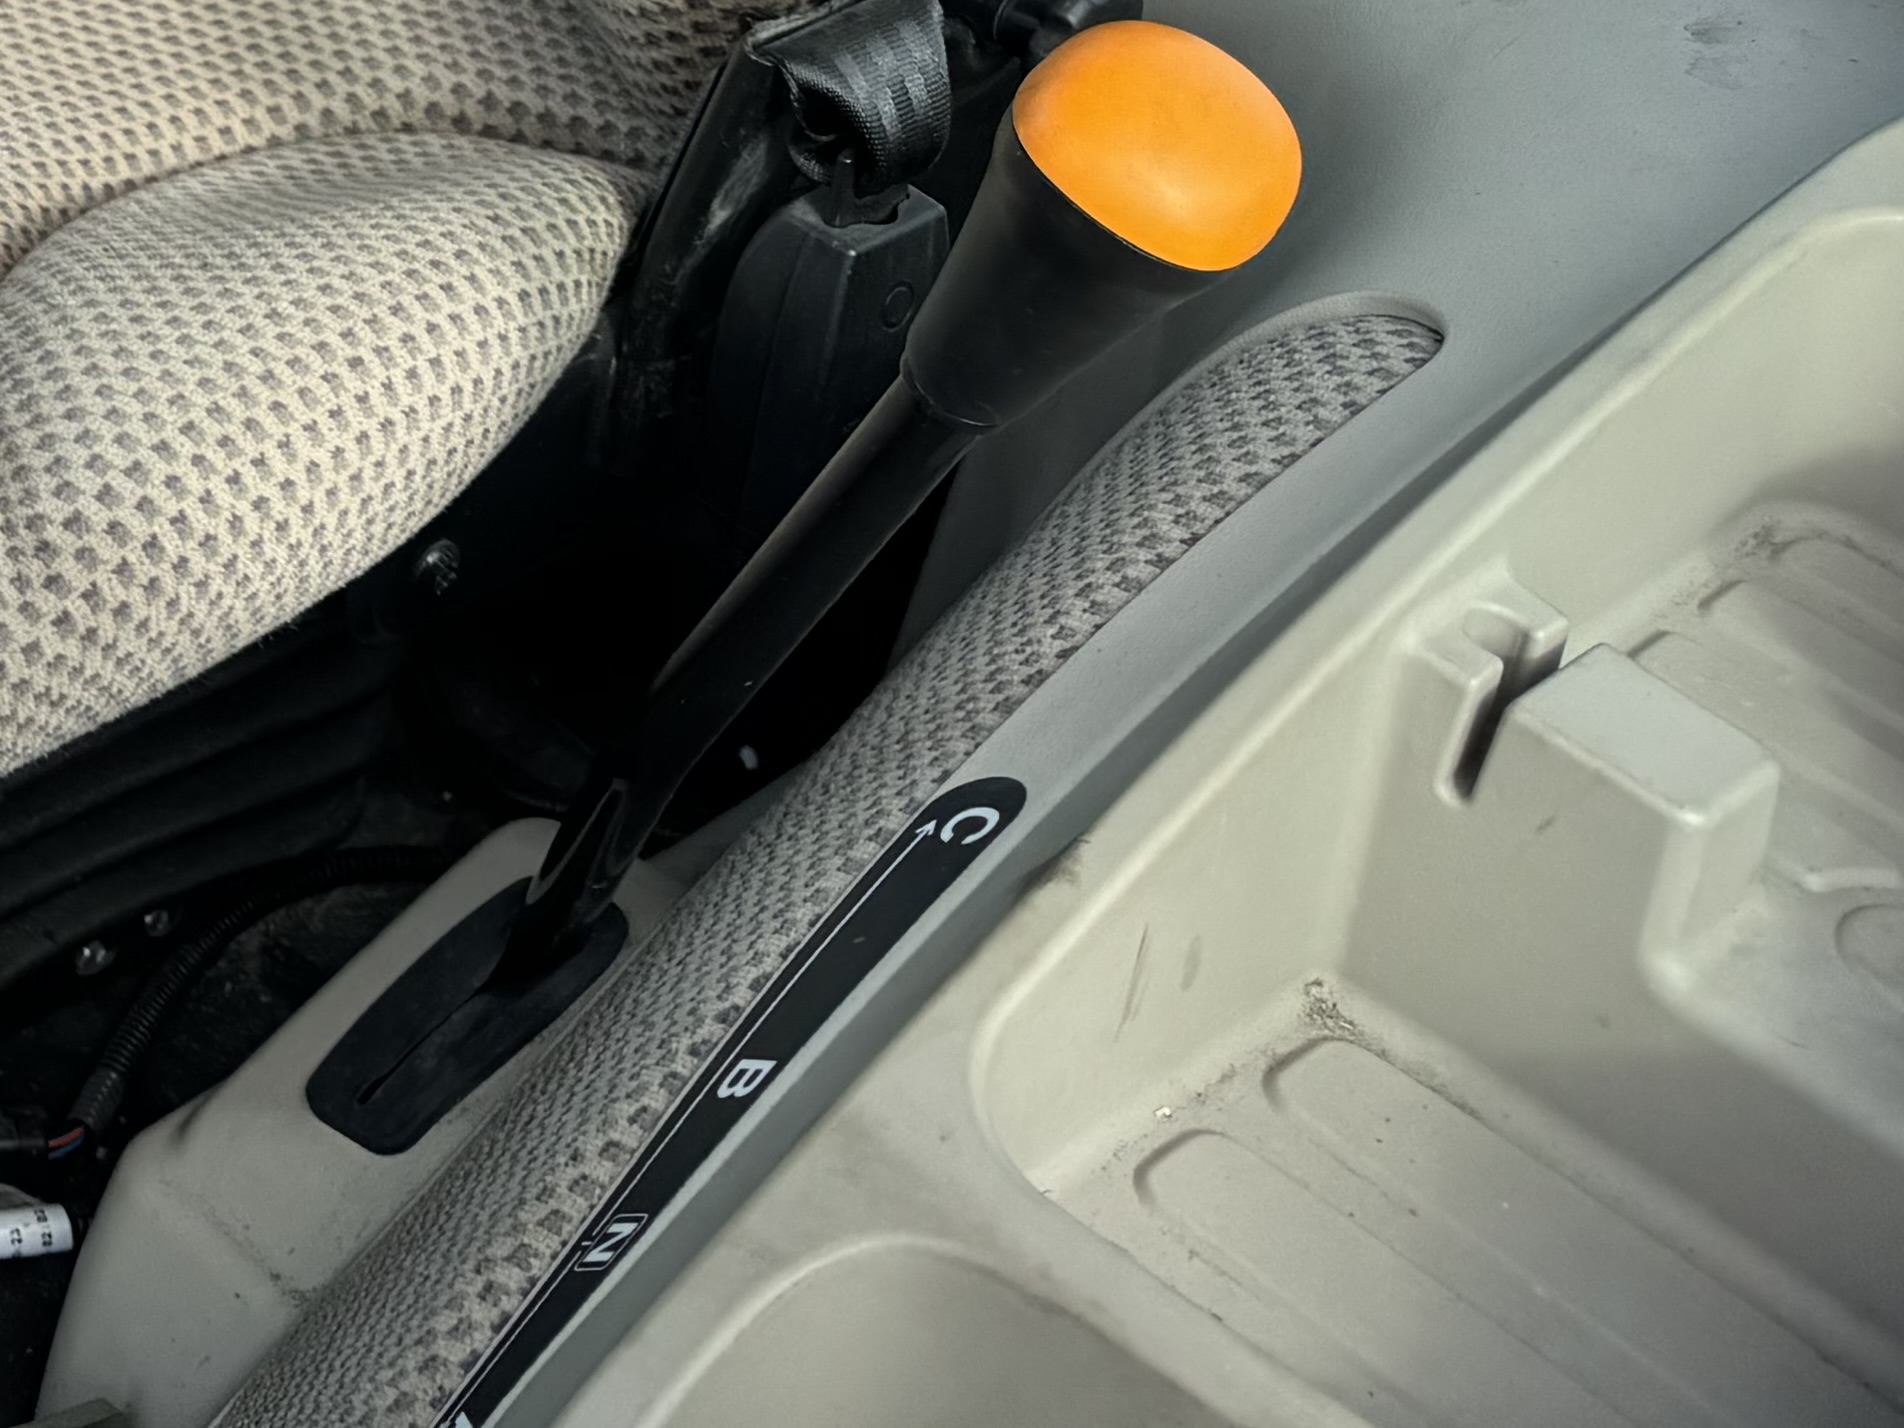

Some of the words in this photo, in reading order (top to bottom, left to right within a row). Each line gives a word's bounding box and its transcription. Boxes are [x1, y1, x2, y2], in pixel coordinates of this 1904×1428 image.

[940, 807, 1000, 845] C
[717, 1059, 777, 1098] B
[582, 1222, 639, 1262] N
